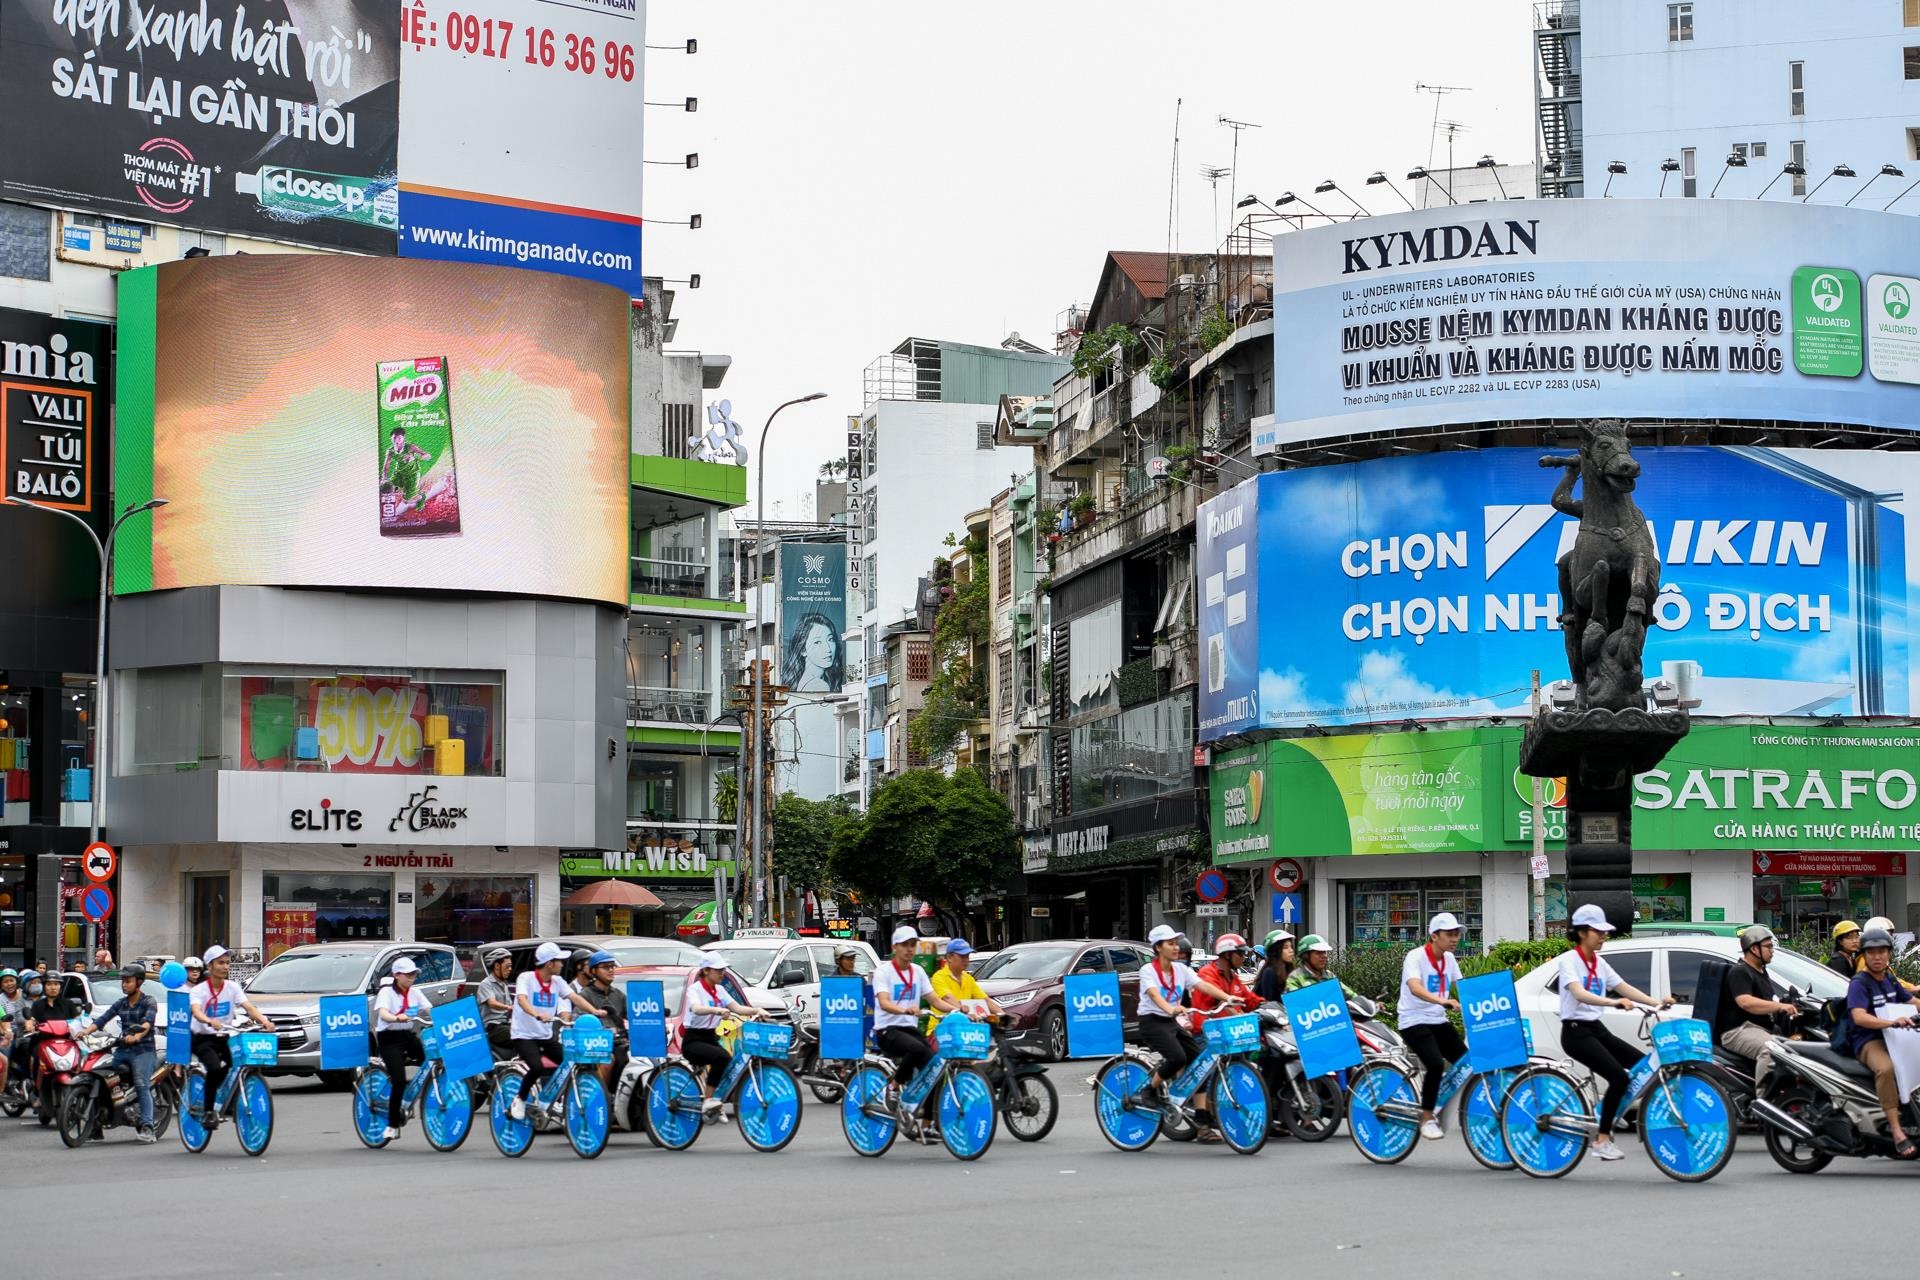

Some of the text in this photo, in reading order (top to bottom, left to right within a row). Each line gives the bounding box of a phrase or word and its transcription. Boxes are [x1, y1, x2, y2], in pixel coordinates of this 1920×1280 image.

[126, 3, 300, 78] xanh bật
[447, 12, 513, 59] 0917
[525, 26, 555, 67] 16
[564, 33, 596, 74] 36
[604, 41, 635, 82] 96
[51, 50, 355, 148] SÁT LẠI GẦN THÔI
[124, 154, 180, 175] THƠM MÁT
[124, 168, 176, 190] VIỆT NAM
[272, 170, 364, 212] closeup
[412, 225, 632, 271] www.kimnganadv.com
[1341, 219, 1540, 274] KYMDAN
[1342, 272, 1535, 301] UL UNDERWRITERS LABORATORIES
[1822, 280, 1834, 294] UL
[1893, 288, 1901, 301] UL
[1342, 283, 1782, 319] LÀ TỔ CHỨC KIỂM NGHIỆM UY TÍN HÀNG ĐẦU THẾ GIỚI CỦA MỸ (USA) CHỨNG NHẬN
[1342, 302, 1783, 352] MOUSSE NỆM KYMDAN KHÁNG ĐƯỢC
[1806, 316, 1851, 328] VALIDATED
[1879, 323, 1918, 336] VALIDATED
[1, 334, 97, 384] mia
[1342, 337, 1783, 388] VI KHUẨN VÀ KHÁNG ĐƯỢC NẤM MỐC
[390, 383, 436, 402] MILO
[1343, 378, 1601, 406] Theo chứng nhận UL ECVP 2282 và UL ECVP 2283 (USA)
[31, 394, 82, 422] VALI
[40, 432, 81, 461] TÚI
[17, 469, 81, 498] BALÔ
[1213, 504, 1243, 537] DAIKIN
[1341, 530, 1468, 581] CHỌN
[1342, 595, 1468, 645] CHỌN
[1484, 594, 1562, 632] NH
[1704, 592, 1831, 641] ĐỊCH
[317, 686, 422, 767] 50%
[1752, 733, 1913, 748] TỔNG CÔNG TY THƯƠNG MẠI SAI GÒN
[1376, 766, 1461, 790] hàng tận gốc
[1404, 790, 1428, 809] mỗi
[1432, 792, 1465, 812] ngày
[420, 806, 468, 819] BLACK
[1057, 831, 1078, 857] MEAT
[1080, 833, 1086, 854] &
[1086, 825, 1109, 853] MEET
[1714, 820, 1747, 838] CỬA
[1752, 822, 1798, 838] HÀNG
[1804, 824, 1846, 841] THỰC
[1851, 820, 1895, 839] PHẨM
[364, 850, 454, 868] 2 NGUYỄN TRÃI
[603, 846, 707, 872] Mr.Wish
[274, 913, 309, 921] SALE
[632, 997, 660, 1016] yola
[825, 994, 858, 1015] yola
[1073, 990, 1114, 1013] yola
[1469, 993, 1511, 1021] yola
[170, 1008, 188, 1025] yola
[326, 1010, 362, 1030] yola
[1297, 1002, 1341, 1030] yola
[441, 1016, 477, 1040] yola
[744, 1031, 760, 1041] yola
[768, 1032, 788, 1045] yola
[960, 1029, 986, 1044] yola
[1229, 1020, 1256, 1039] yola
[1689, 1029, 1709, 1045] yola
[248, 1039, 272, 1053] yola
[584, 1036, 609, 1050] yola
[1656, 1033, 1679, 1047] yola
[1659, 1144, 1677, 1164] yola
